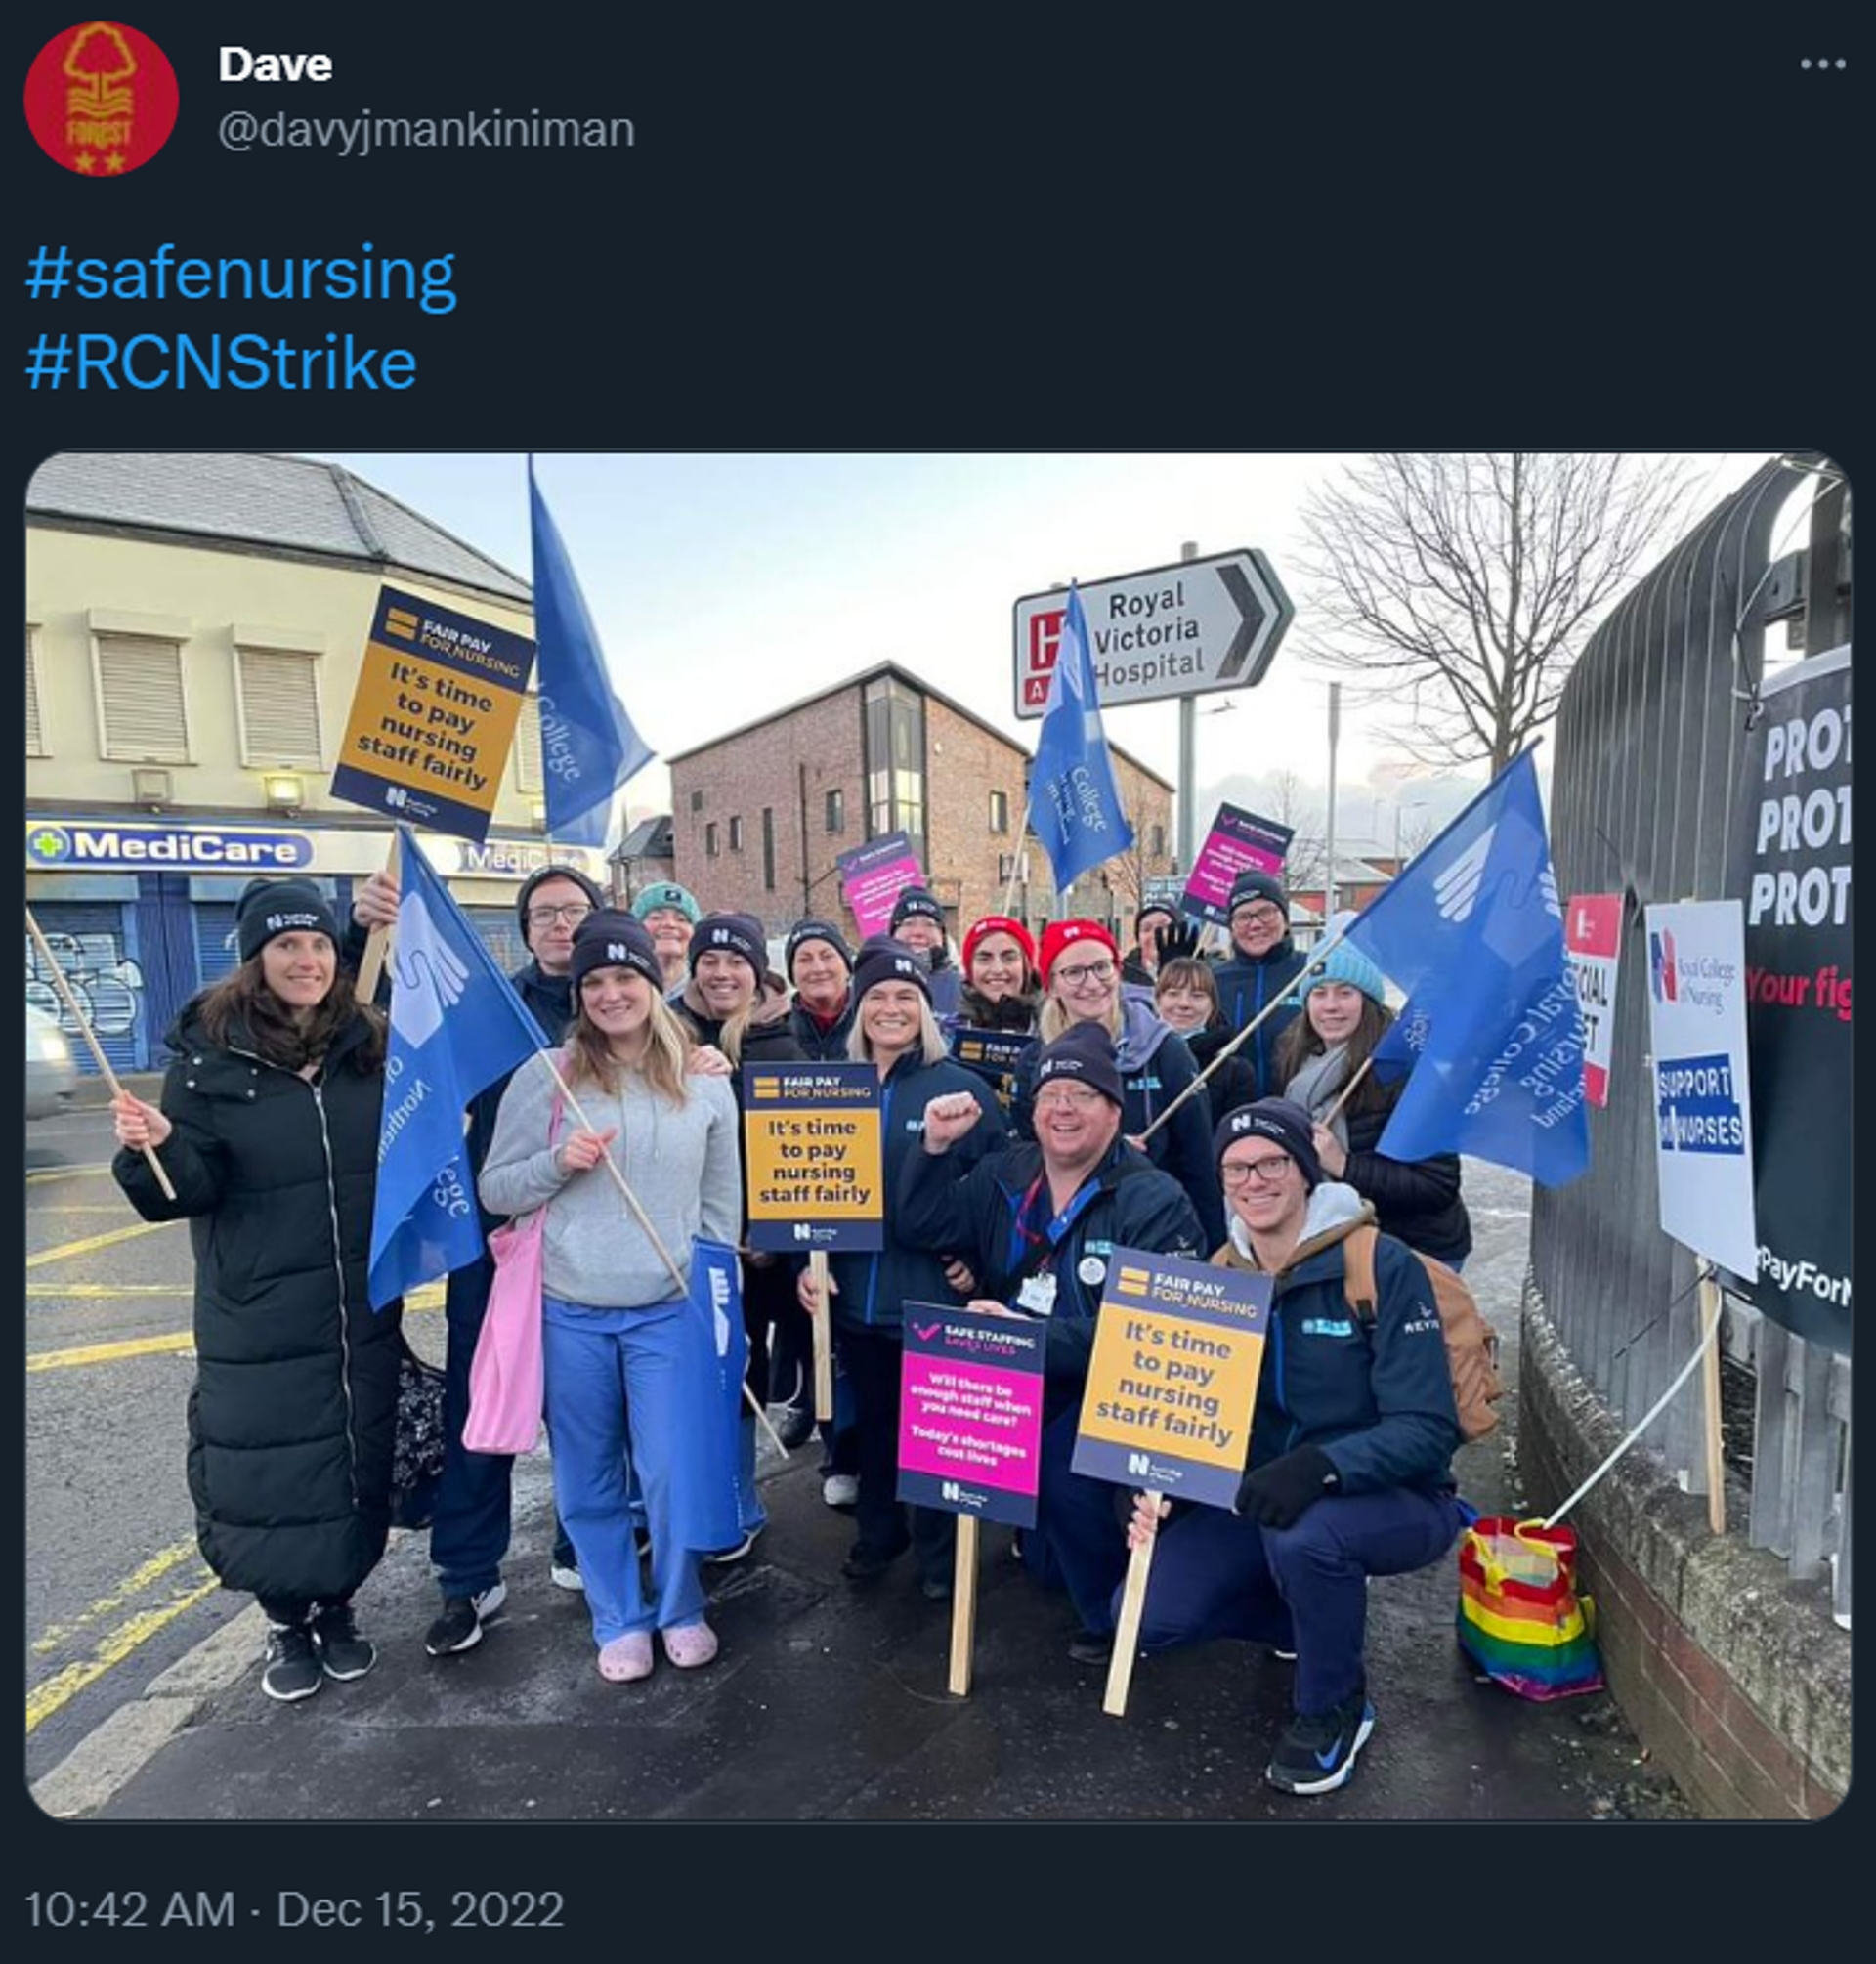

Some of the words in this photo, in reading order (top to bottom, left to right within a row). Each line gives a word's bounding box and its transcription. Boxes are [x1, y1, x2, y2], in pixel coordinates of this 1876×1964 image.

[1109, 581, 1185, 619] Royal
[423, 619, 459, 642] FAIR
[460, 633, 491, 654] PAY
[1094, 617, 1200, 655] Victoria
[420, 633, 450, 653] FOR
[449, 644, 521, 679] NURSING
[1094, 648, 1205, 687] Hospital
[390, 662, 428, 690] It's
[435, 678, 493, 713] time
[397, 692, 423, 714] to
[427, 706, 475, 735] pay
[380, 714, 478, 764] nursing
[357, 734, 420, 767] staff
[423, 753, 488, 791] fairly
[1072, 766, 1107, 833] College
[73, 831, 299, 863] MediCare
[1747, 866, 1851, 927] PROT
[1746, 965, 1811, 1006] Your
[783, 1077, 813, 1087] FAIR
[815, 1076, 841, 1087] PAY
[783, 1087, 809, 1098] FOR
[810, 1087, 872, 1100] NURSING
[1660, 1066, 1730, 1098] SUPPORT
[769, 1120, 802, 1135] It's
[807, 1119, 857, 1135] time
[781, 1143, 803, 1158] to
[808, 1145, 847, 1161] pay
[773, 1163, 856, 1183] nursing
[760, 1185, 810, 1203] staff
[815, 1183, 872, 1205] fairly
[1153, 1273, 1190, 1293] FAIR
[1192, 1281, 1225, 1297] PAY
[1758, 1244, 1852, 1307] PayFor
[1151, 1286, 1182, 1303] FOR
[1182, 1294, 1258, 1319] NURSING
[1126, 1321, 1164, 1345] It's
[1171, 1330, 1232, 1359] time
[929, 1372, 957, 1387] Will
[958, 1378, 993, 1394] there
[996, 1385, 1013, 1397] be
[1133, 1350, 1161, 1372] to
[1165, 1359, 1215, 1388] pay
[910, 1385, 959, 1403] enough
[961, 1393, 993, 1407] staff
[994, 1400, 1032, 1417] when
[921, 1400, 946, 1415] you
[948, 1405, 981, 1422] need
[983, 1412, 1018, 1428] care?
[1119, 1377, 1220, 1417] nursing
[912, 1424, 959, 1445] Today's
[961, 1434, 1027, 1458] shortages
[1096, 1400, 1160, 1428] staff
[1164, 1412, 1233, 1449] fairly
[937, 1446, 964, 1461] cost
[966, 1449, 998, 1467] lives
